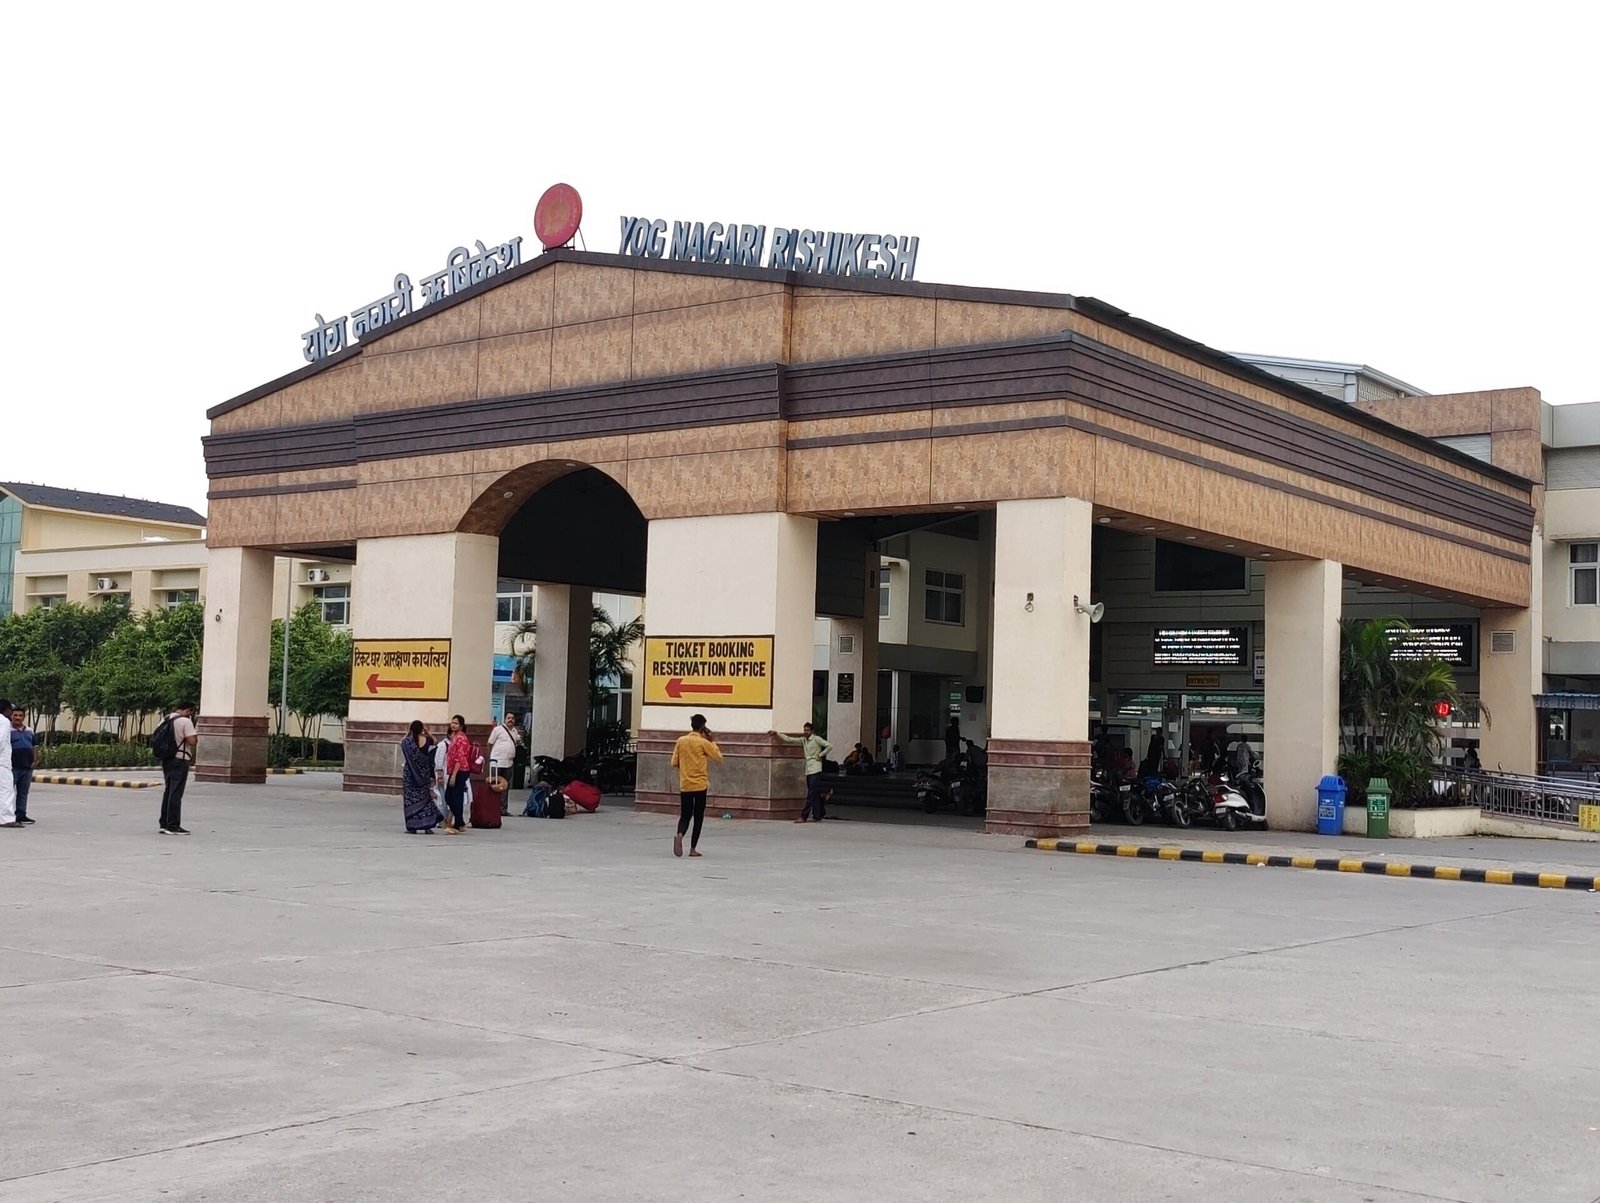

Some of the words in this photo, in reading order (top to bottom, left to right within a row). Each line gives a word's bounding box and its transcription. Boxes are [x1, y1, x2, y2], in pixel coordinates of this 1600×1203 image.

[620, 215, 667, 258] YOG
[669, 220, 766, 268] NAGARI
[768, 227, 919, 282] RISHIKESH
[301, 313, 348, 362] योग
[350, 272, 414, 339] नगरी
[383, 650, 411, 670] आरक्षण
[412, 646, 448, 667] कार्यालय
[665, 642, 705, 658] TICKET
[708, 642, 755, 658] BOOKING
[652, 661, 726, 676] RESERVATION
[729, 661, 766, 677] OFFICE
